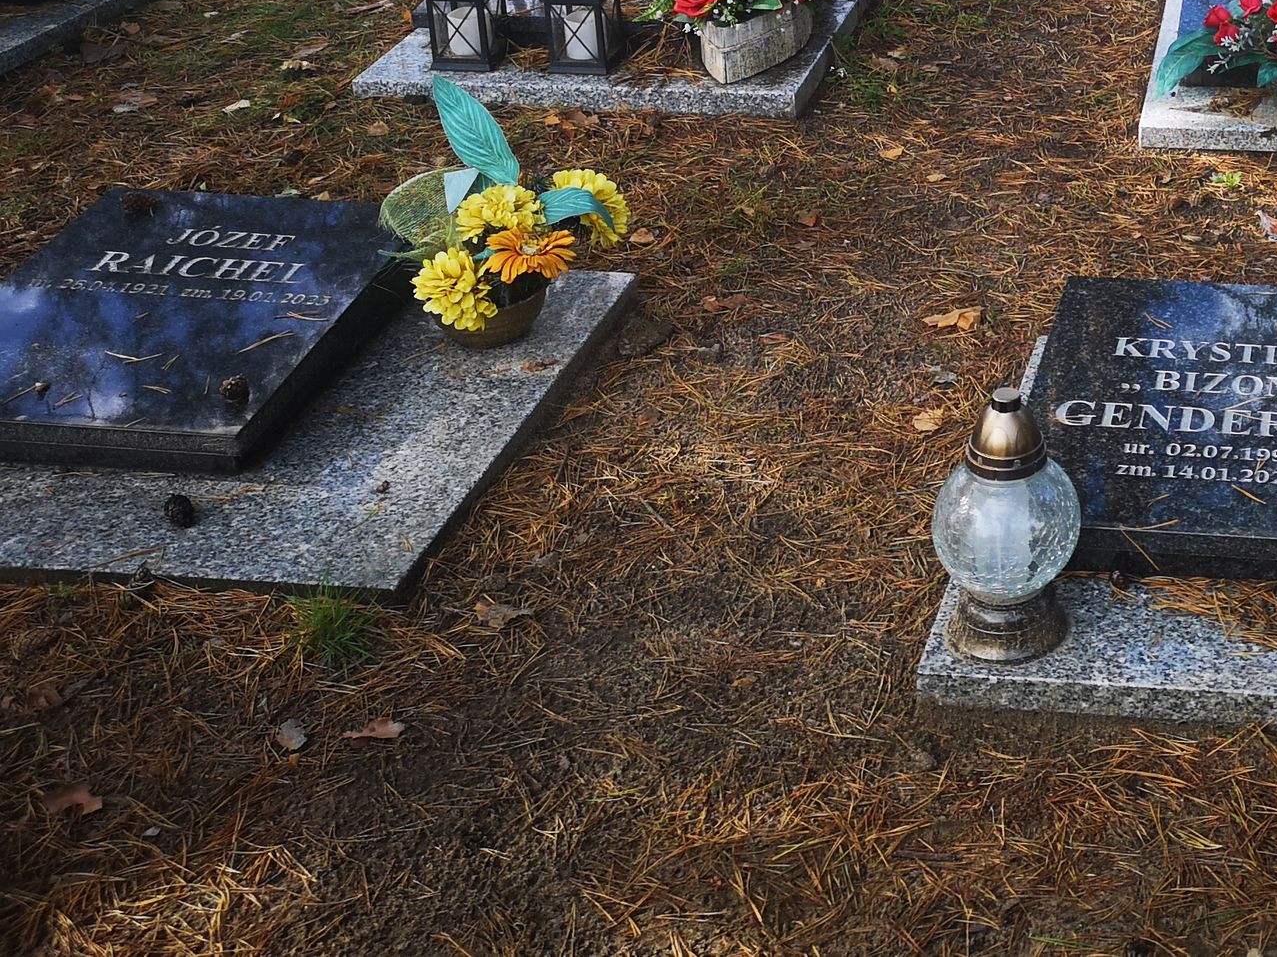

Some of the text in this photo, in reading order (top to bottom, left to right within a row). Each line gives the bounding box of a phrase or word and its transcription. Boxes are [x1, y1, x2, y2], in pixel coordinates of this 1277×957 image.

[166, 225, 297, 252] JÓZEF
[86, 250, 305, 285] RAICHEL
[1123, 443, 1154, 455] ur.
[1115, 464, 1157, 478] zm.
